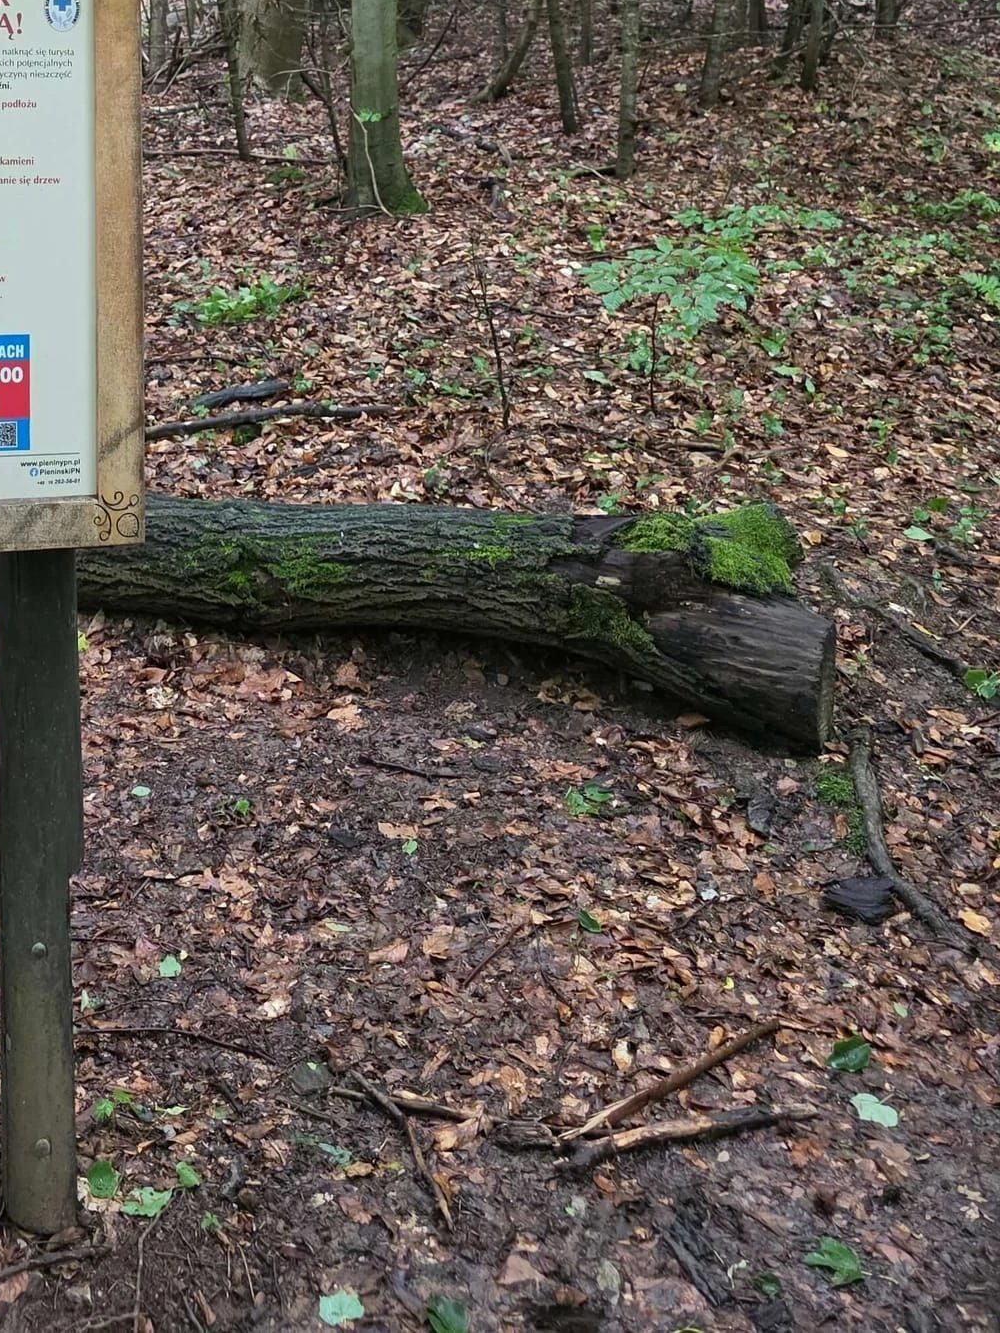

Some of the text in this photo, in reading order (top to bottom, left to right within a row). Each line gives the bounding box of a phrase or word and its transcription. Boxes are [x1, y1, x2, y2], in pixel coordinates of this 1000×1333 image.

[2, 47, 33, 57] natknąć
[36, 48, 46, 57] się
[49, 48, 74, 57] turysta
[17, 58, 72, 68] potencjalnych
[30, 70, 71, 79] nieszczęść
[2, 99, 37, 110] podłożu
[0, 156, 34, 165] kamieni
[19, 175, 30, 186] się
[33, 175, 60, 184] drzew
